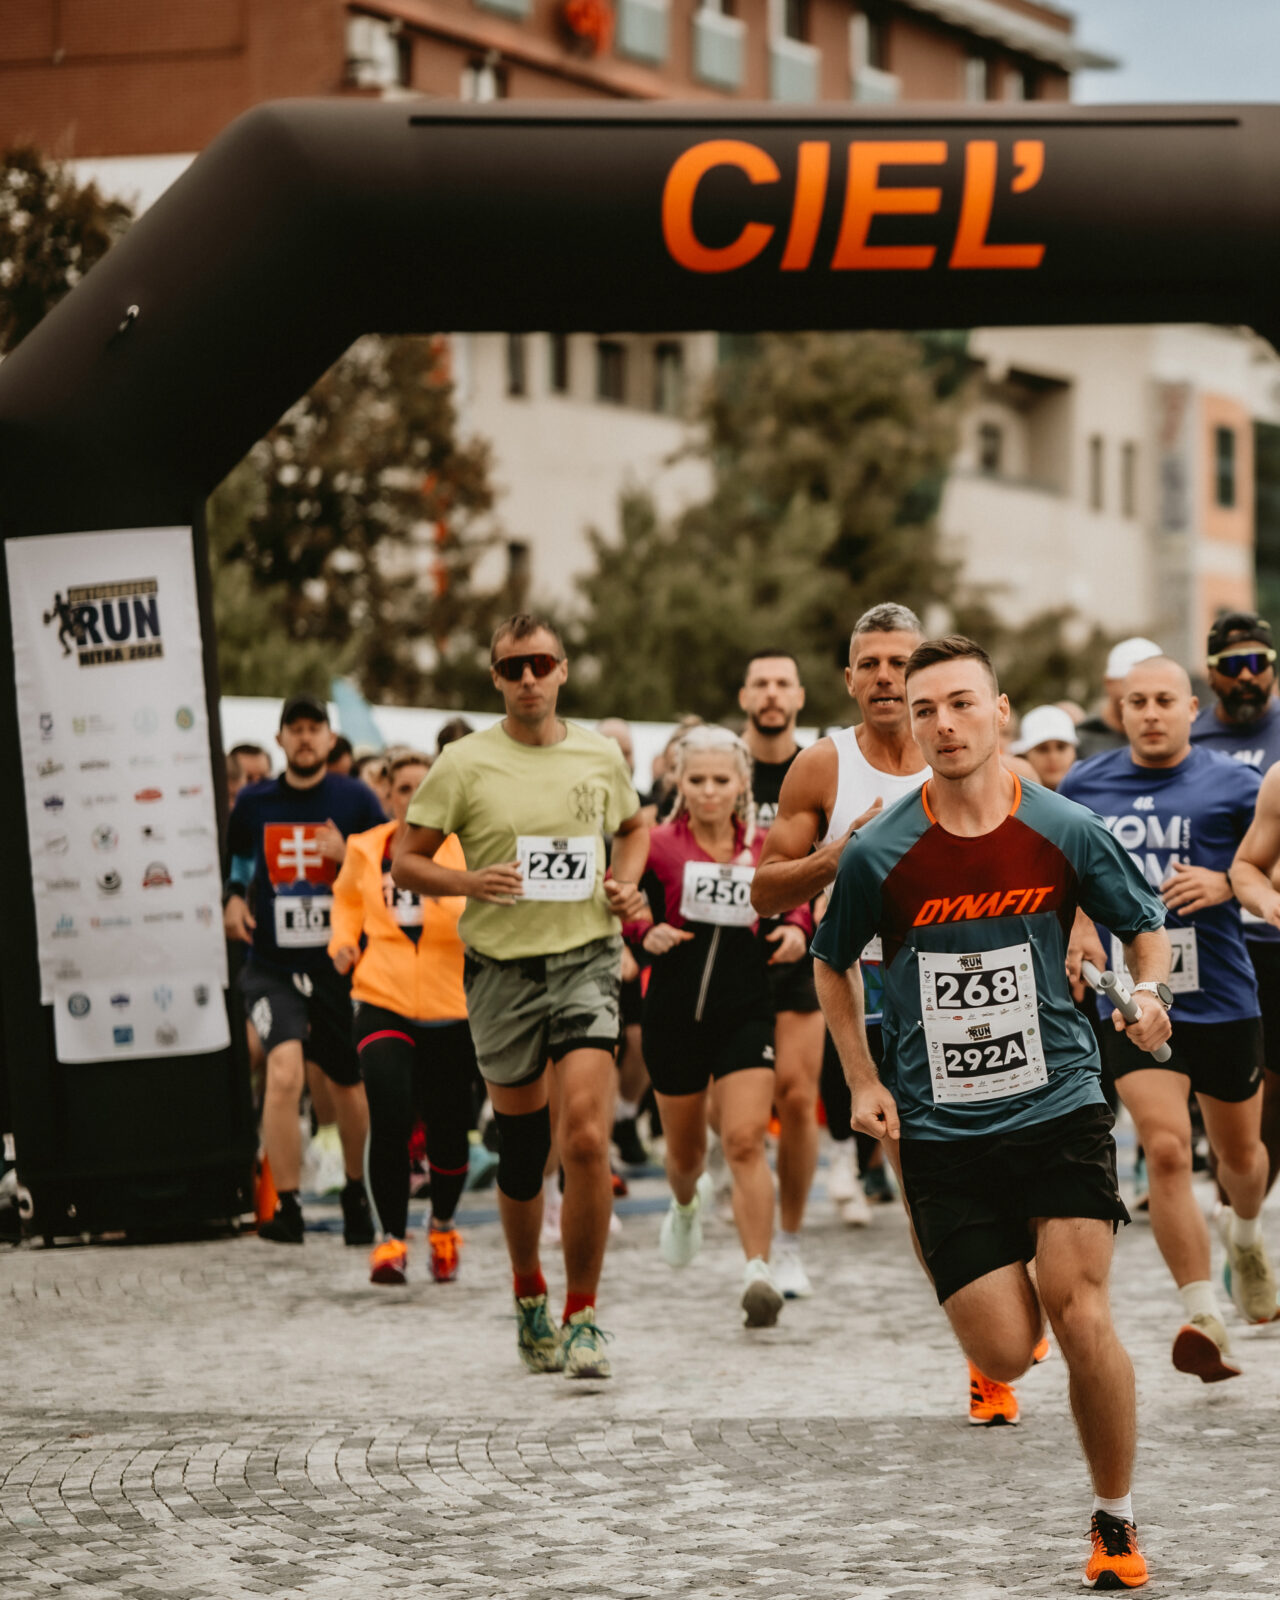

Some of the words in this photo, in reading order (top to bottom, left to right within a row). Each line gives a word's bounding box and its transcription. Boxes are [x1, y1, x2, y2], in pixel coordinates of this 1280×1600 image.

[662, 139, 1047, 273] CIEĽ
[73, 598, 161, 646] RUN
[530, 853, 587, 880] 267
[697, 878, 751, 905] 250
[912, 885, 1056, 927] DYNAFIT
[963, 956, 983, 968] RUN
[936, 970, 1018, 1007] 268
[972, 1026, 992, 1038] RUN
[945, 1039, 1026, 1072] 292A
